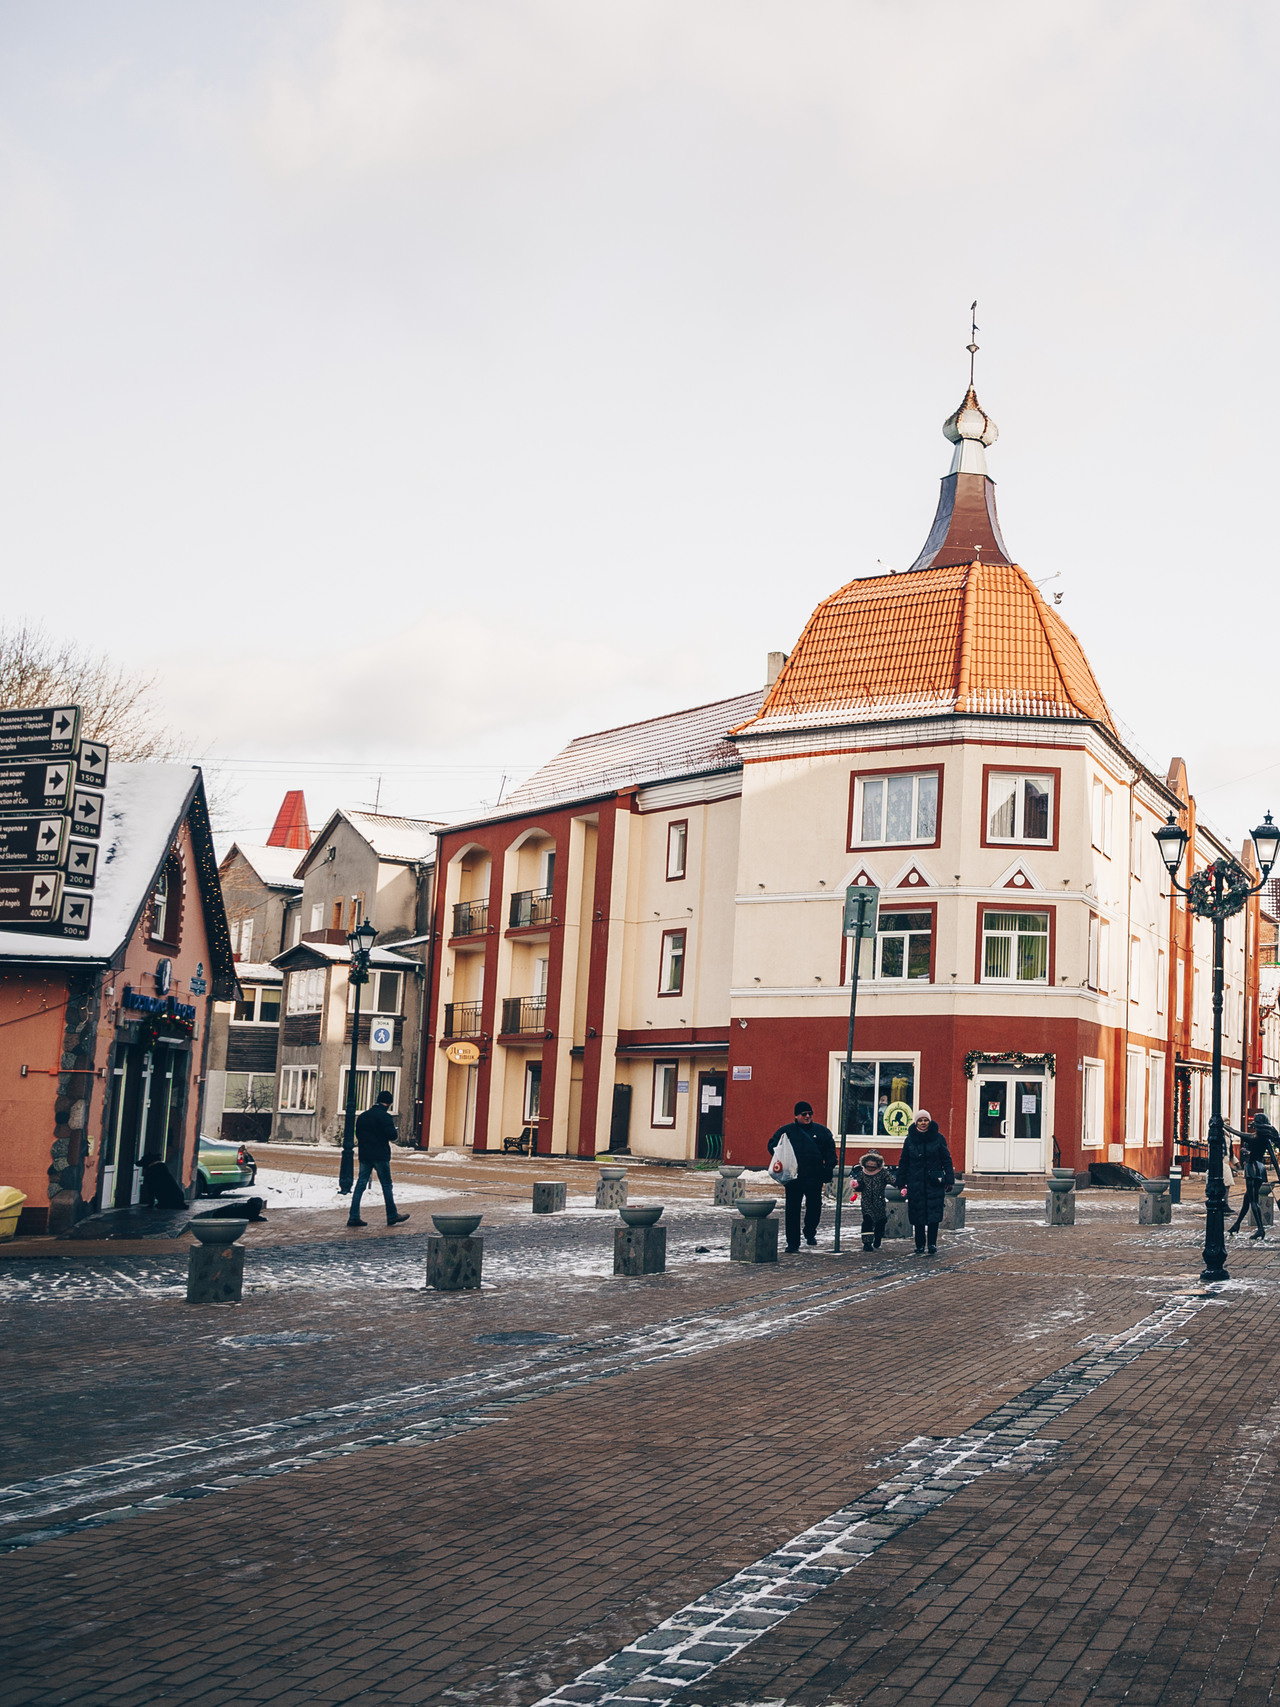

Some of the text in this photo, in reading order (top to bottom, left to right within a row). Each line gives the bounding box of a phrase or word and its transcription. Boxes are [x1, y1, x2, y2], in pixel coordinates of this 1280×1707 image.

[51, 742, 64, 750] 250
[81, 774, 94, 782] 150
[44, 798, 56, 806] 250
[75, 824, 89, 833] 950
[36, 854, 49, 862] 250
[70, 876, 83, 884] 200
[5, 900, 20, 908] Angels
[30, 909, 42, 917] 400
